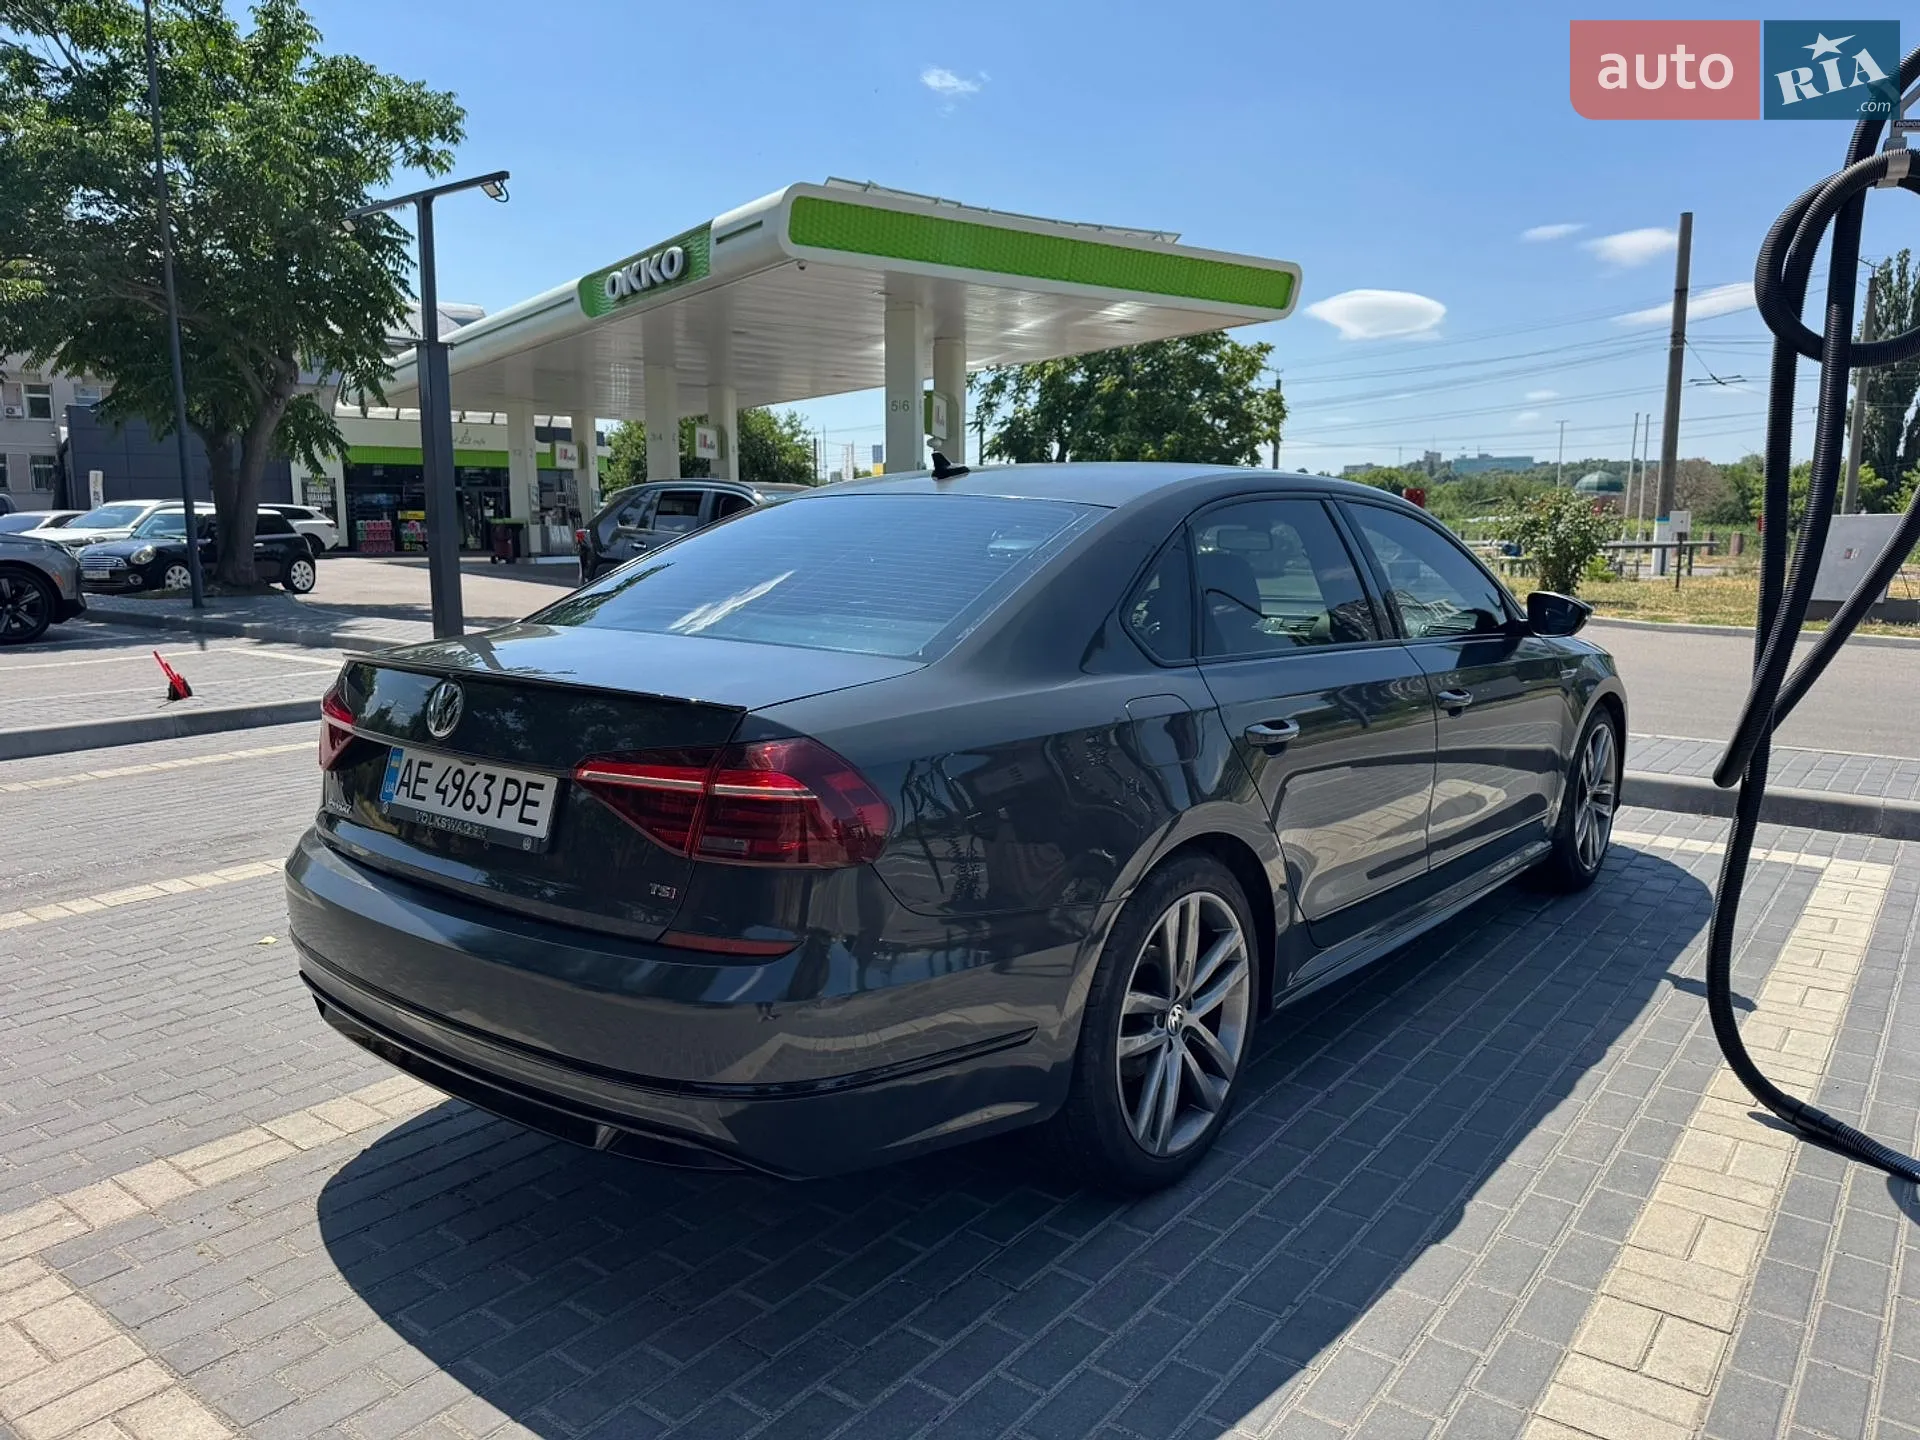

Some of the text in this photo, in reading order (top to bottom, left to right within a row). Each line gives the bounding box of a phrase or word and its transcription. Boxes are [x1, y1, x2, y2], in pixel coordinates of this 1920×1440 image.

[604, 246, 685, 300] OKKO
[397, 758, 545, 827] AE 4963 PE
[649, 882, 677, 899] TSI
